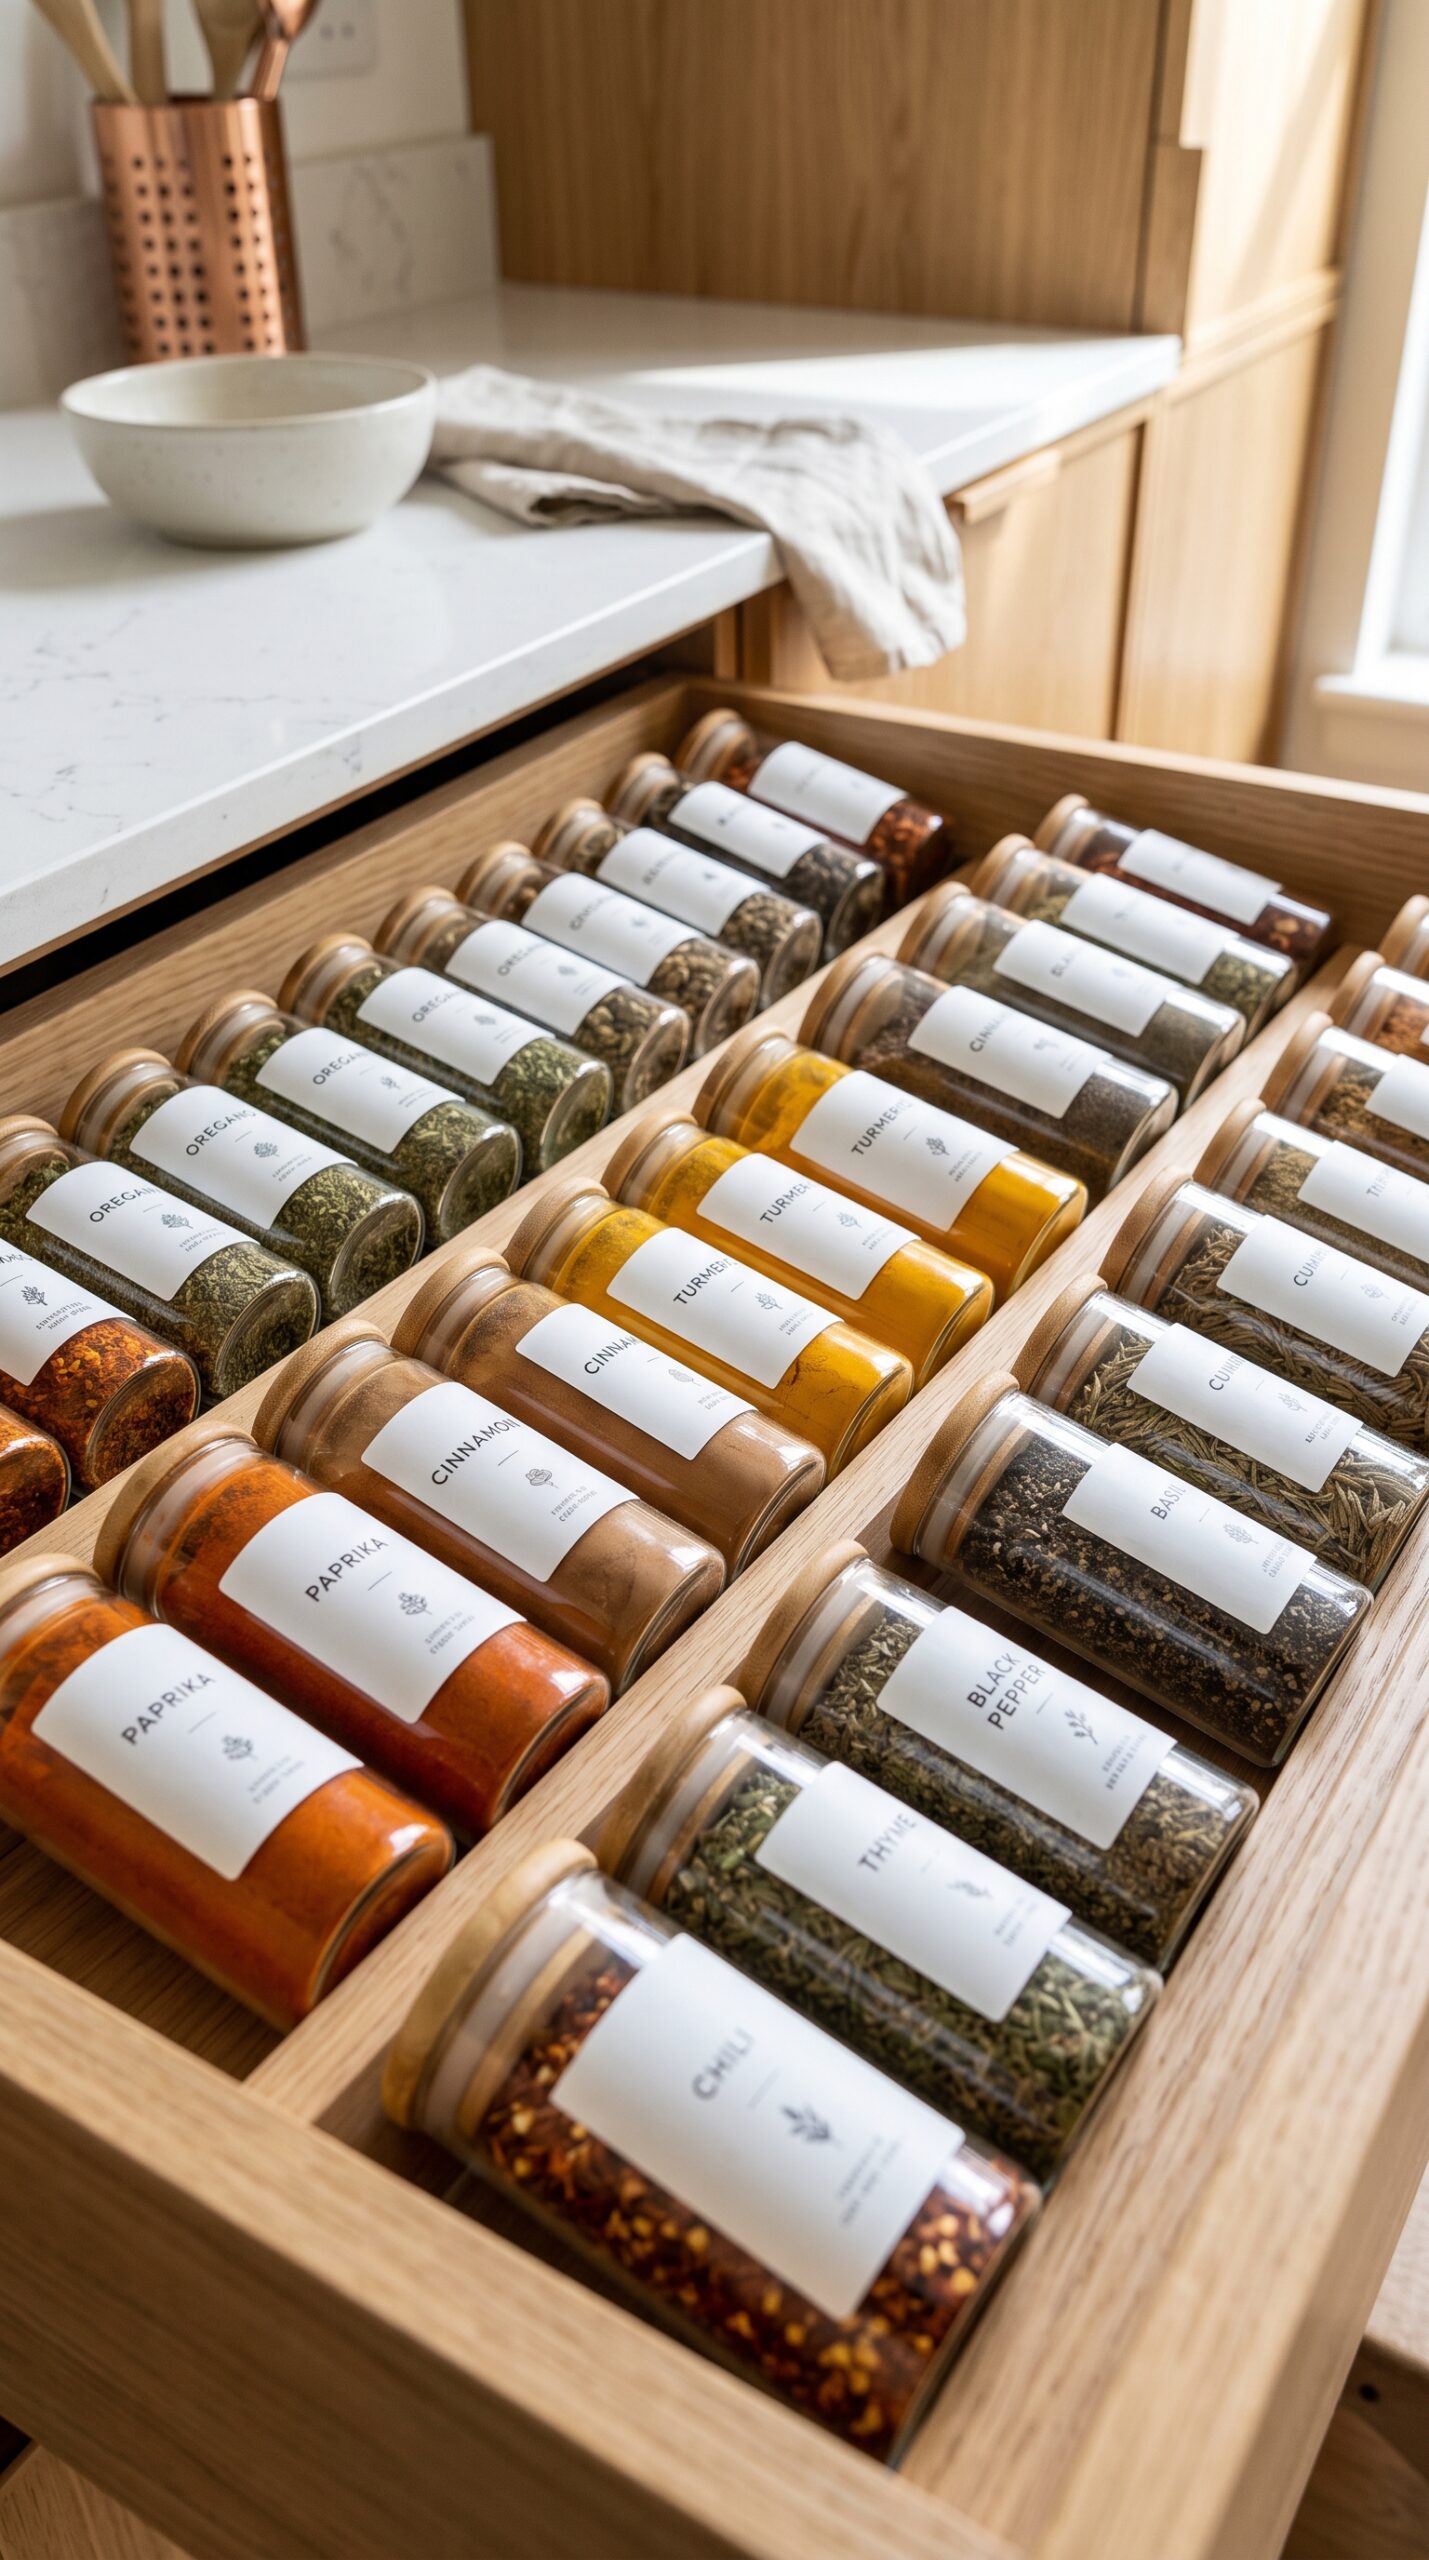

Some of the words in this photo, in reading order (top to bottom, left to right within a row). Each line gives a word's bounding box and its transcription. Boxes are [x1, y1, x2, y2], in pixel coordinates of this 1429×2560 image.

[1150, 1484, 1187, 1520] BASIL
[305, 1536, 389, 1602] PAPRIKA
[121, 1672, 215, 1745] PAPRIKA
[967, 1652, 1020, 1708] BLACK
[987, 1664, 1046, 1730] PEPPER
[858, 1812, 918, 1873] THYME
[692, 2027, 755, 2101] CHILI
